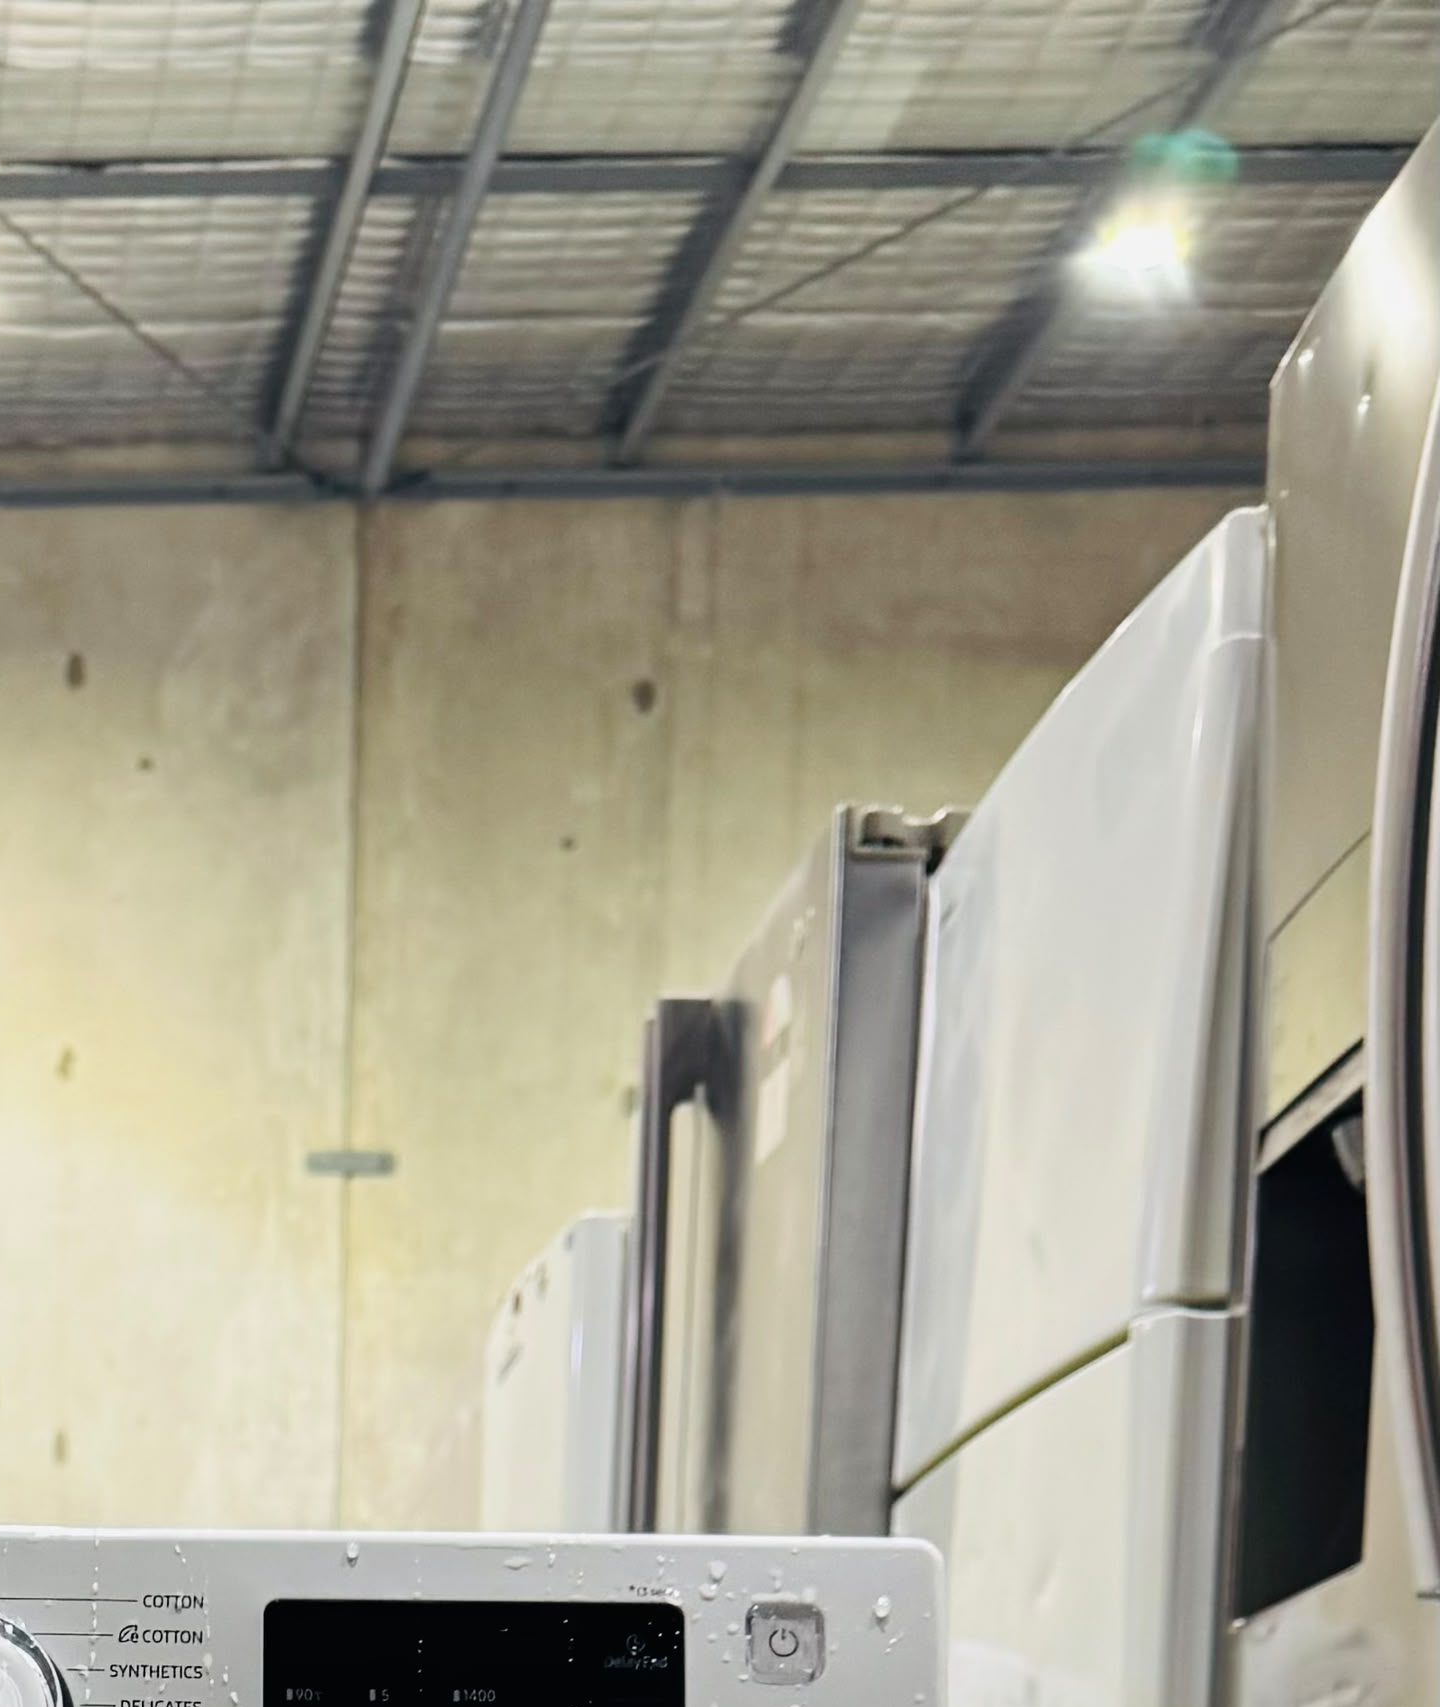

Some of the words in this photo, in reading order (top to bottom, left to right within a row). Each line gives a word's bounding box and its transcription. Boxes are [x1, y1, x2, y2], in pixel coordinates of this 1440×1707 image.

[143, 1594, 204, 1609] COTTON
[142, 1629, 203, 1644] COTTON
[109, 1664, 203, 1679] SYNTHETICS
[381, 1689, 390, 1701] 5
[463, 1689, 496, 1701] 1400
